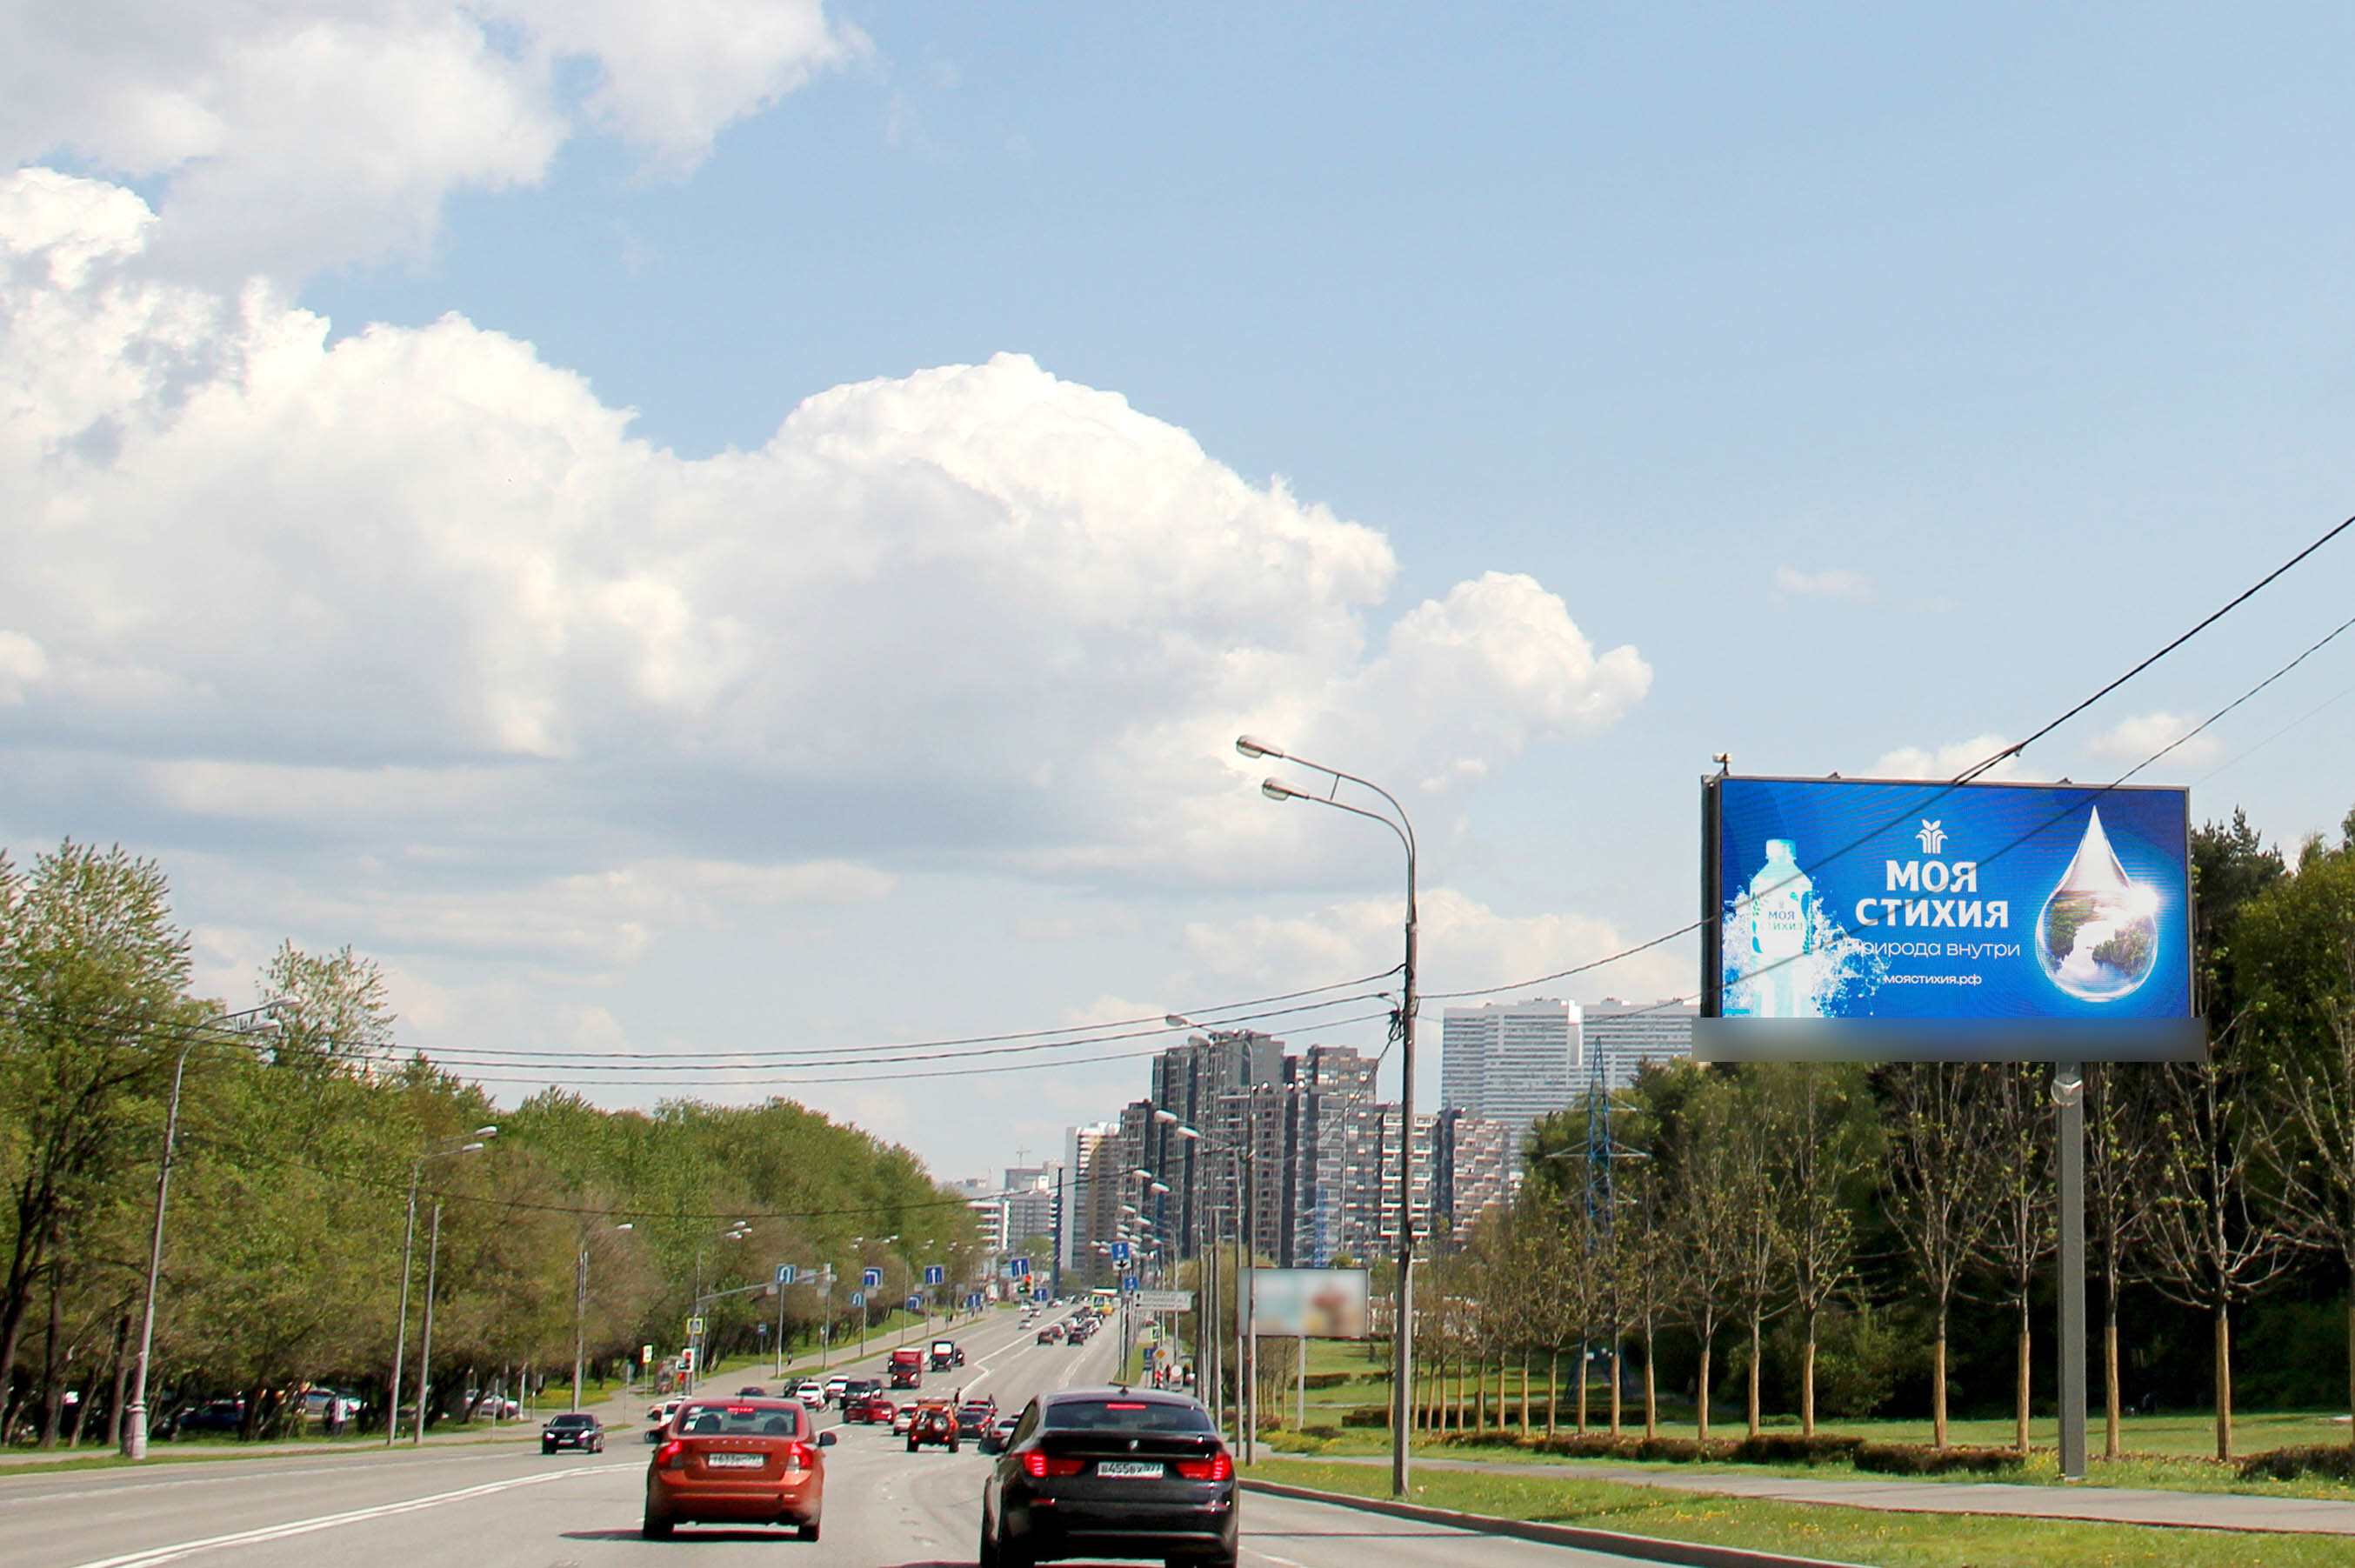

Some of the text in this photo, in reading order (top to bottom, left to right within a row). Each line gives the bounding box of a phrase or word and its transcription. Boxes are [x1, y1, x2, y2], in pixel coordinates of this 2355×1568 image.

[1885, 860, 1978, 892] МОЯ
[1768, 911, 1795, 920] МОЯ
[1855, 898, 2009, 928] СТИХИЯ
[1847, 941, 2021, 960] рирода внутри
[1885, 973, 1982, 986] моястихия.рф
